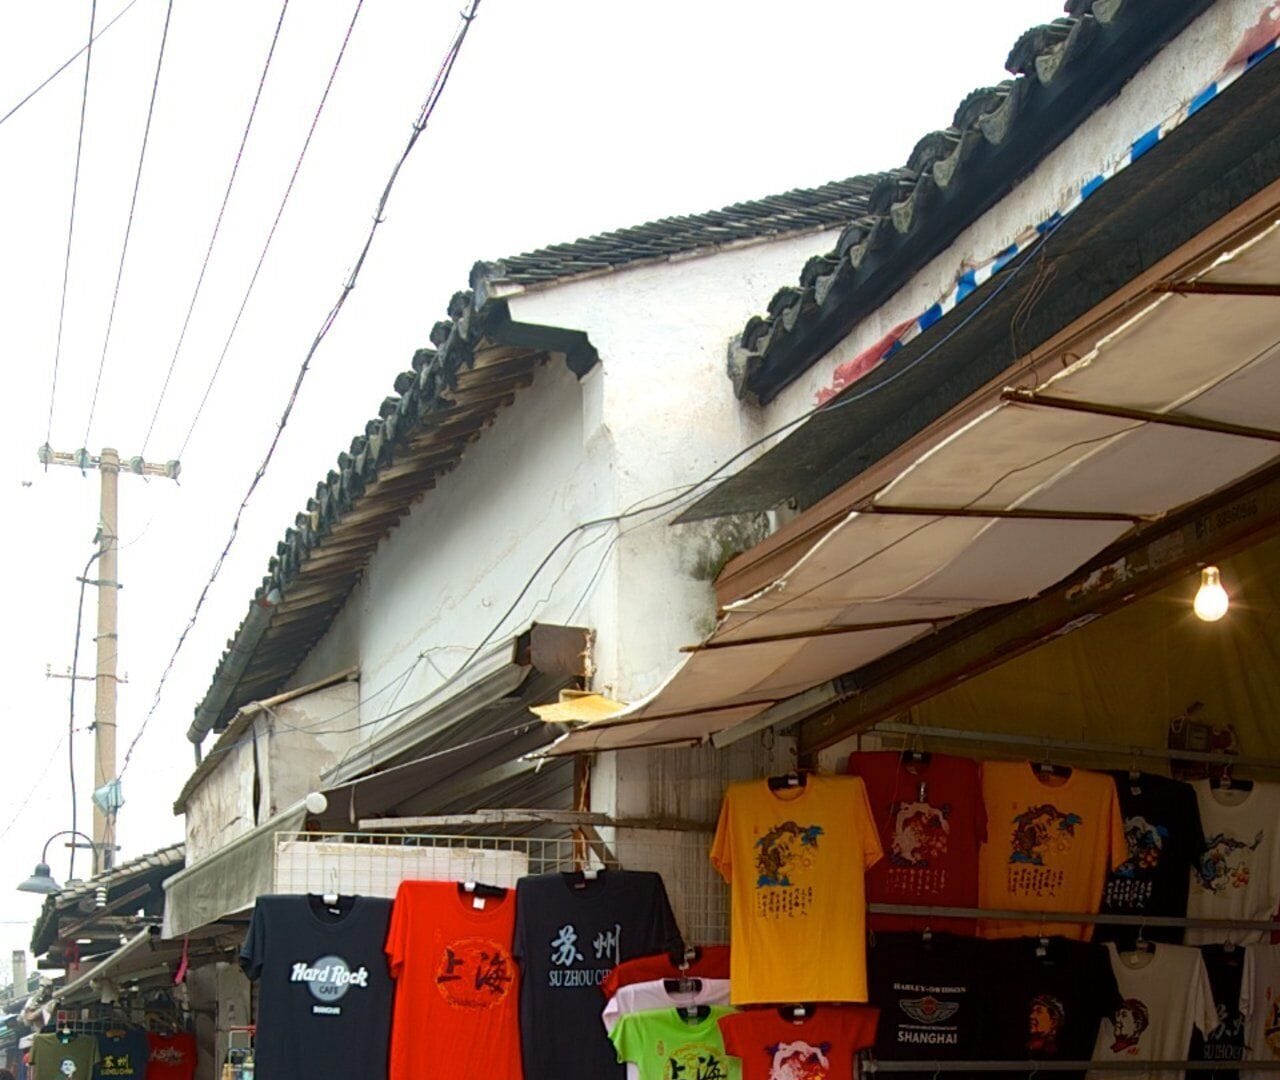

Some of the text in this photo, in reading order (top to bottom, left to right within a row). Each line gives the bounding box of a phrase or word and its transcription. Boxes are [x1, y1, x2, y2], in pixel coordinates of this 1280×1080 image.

[551, 924, 620, 967] 苏州
[291, 963, 369, 987] Hard Rock
[437, 948, 512, 994] 上海
[897, 1031, 959, 1044] SHANGHAI
